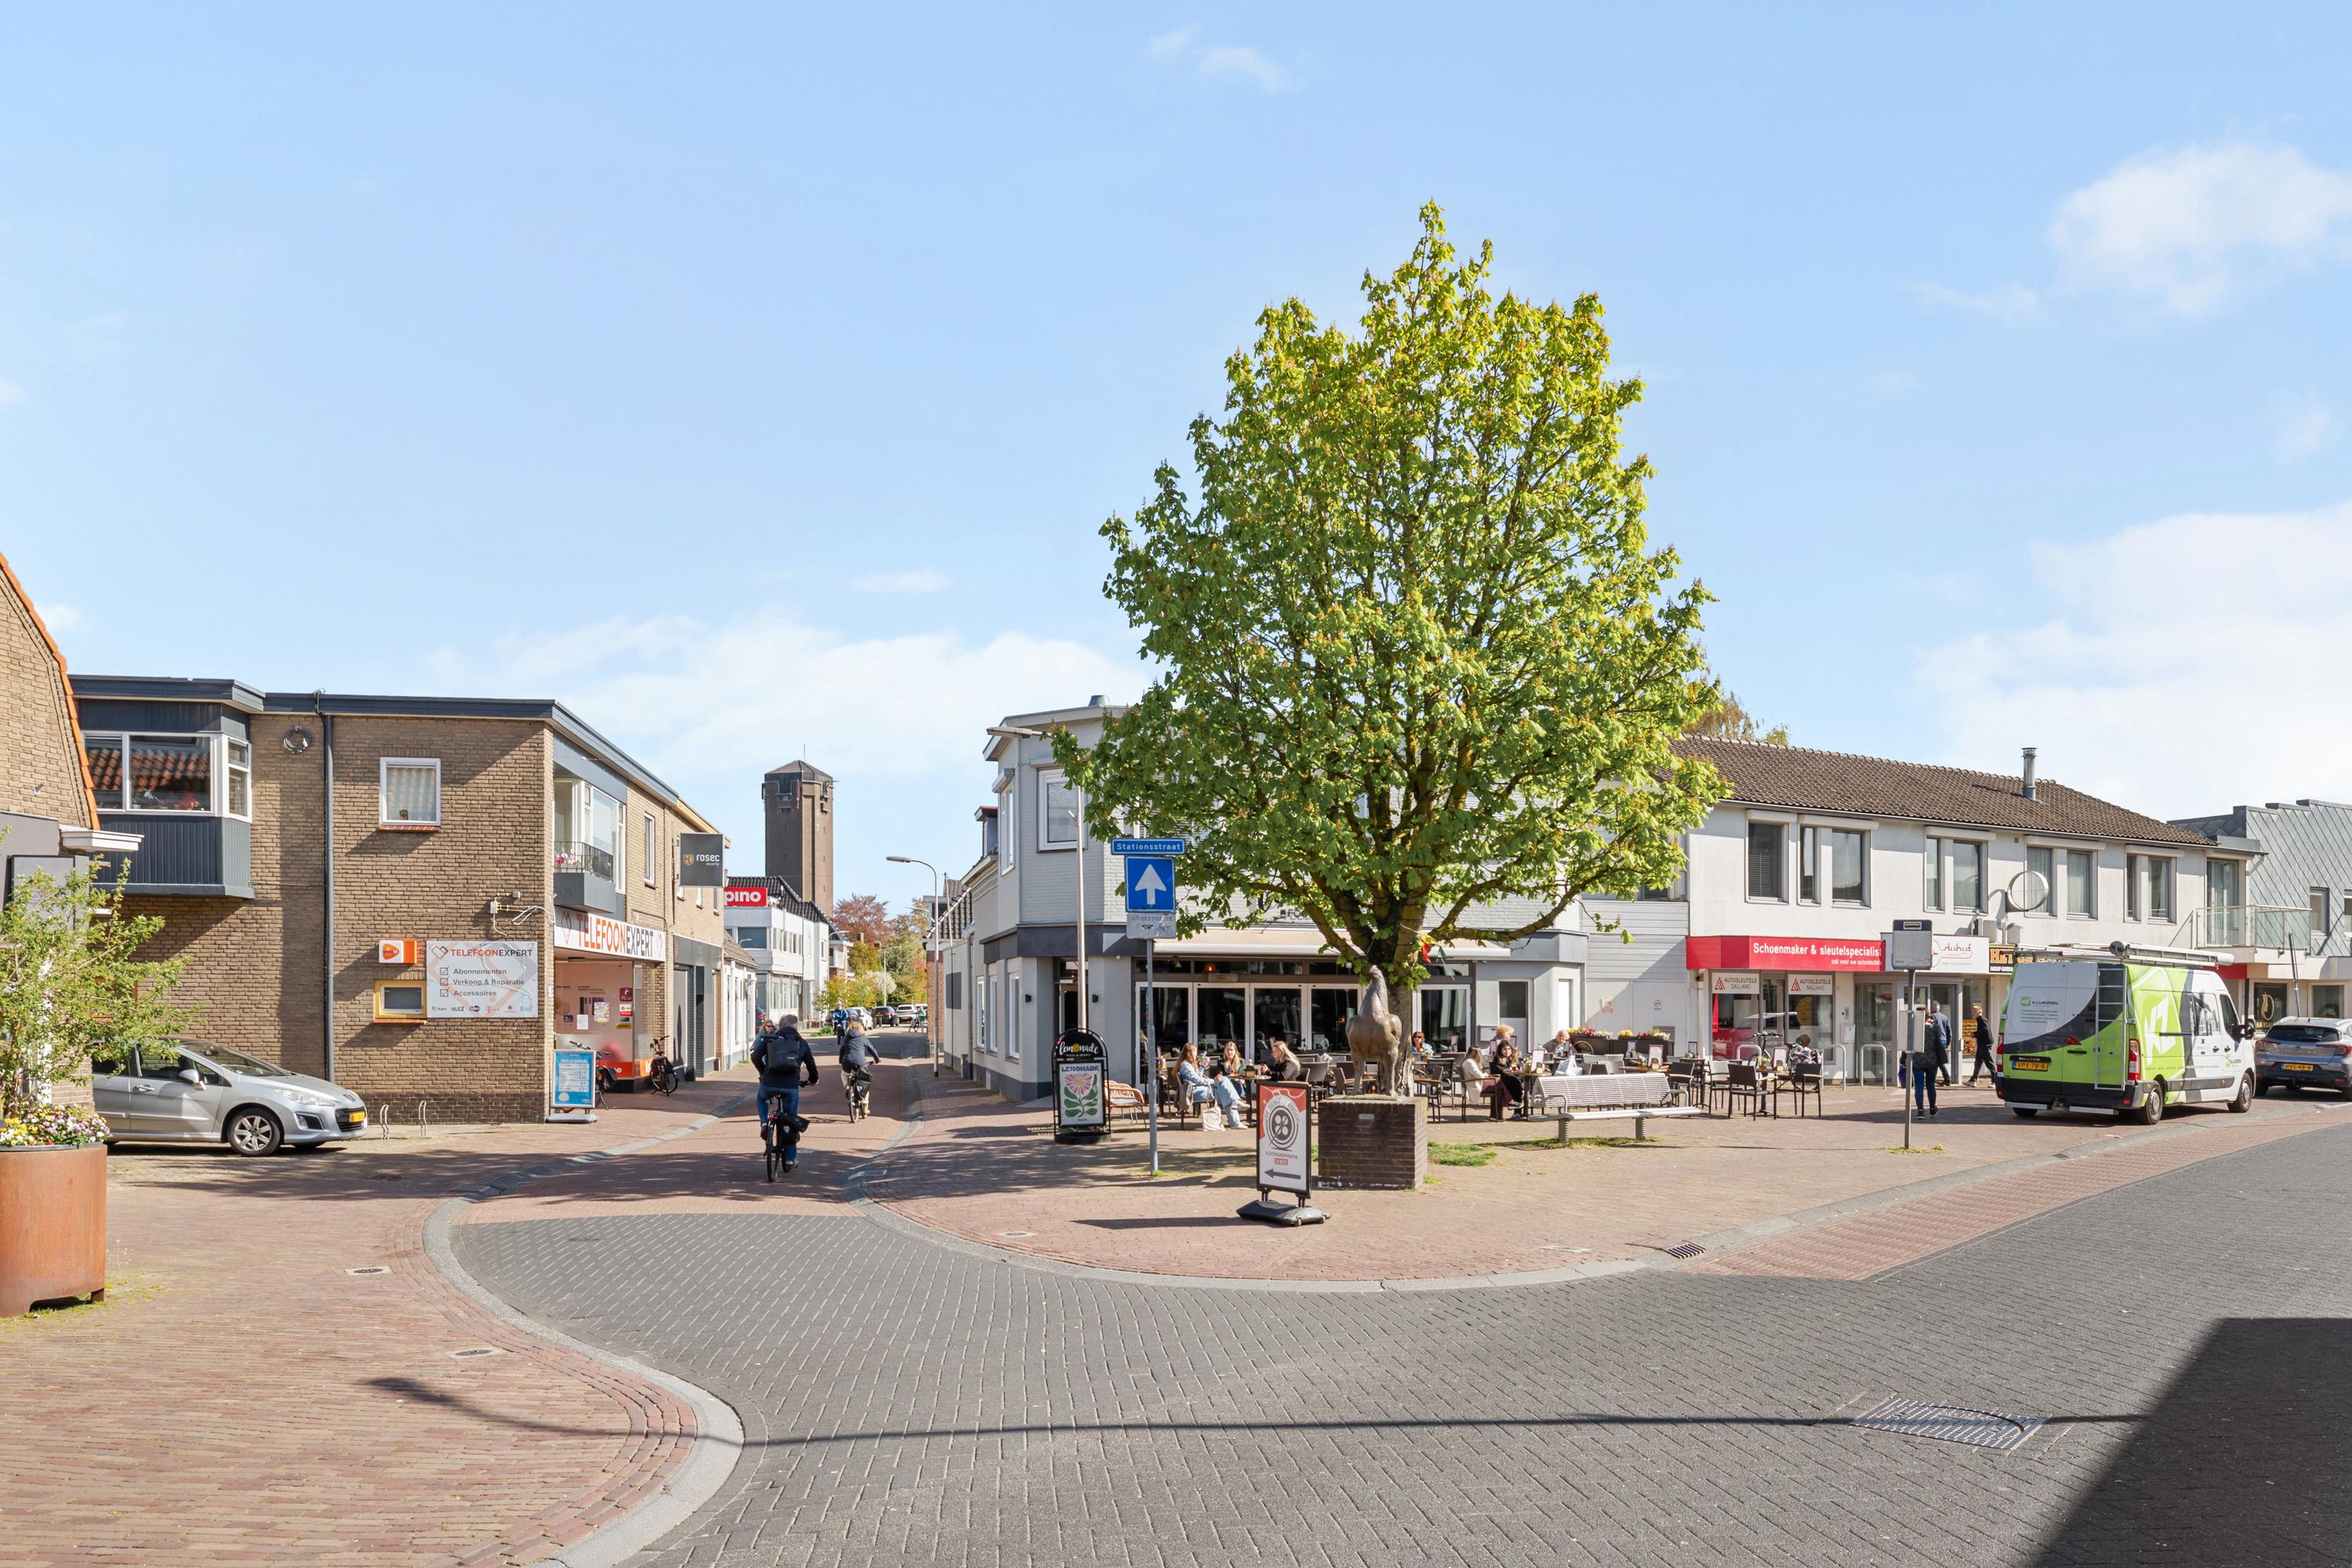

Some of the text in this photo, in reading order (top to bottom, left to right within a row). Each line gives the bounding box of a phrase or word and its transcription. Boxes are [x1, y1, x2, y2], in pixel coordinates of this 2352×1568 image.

[576, 913, 654, 957] TELEFOONEXPERT
[1753, 942, 1882, 959] Schoenmaker & sleutelspecialist
